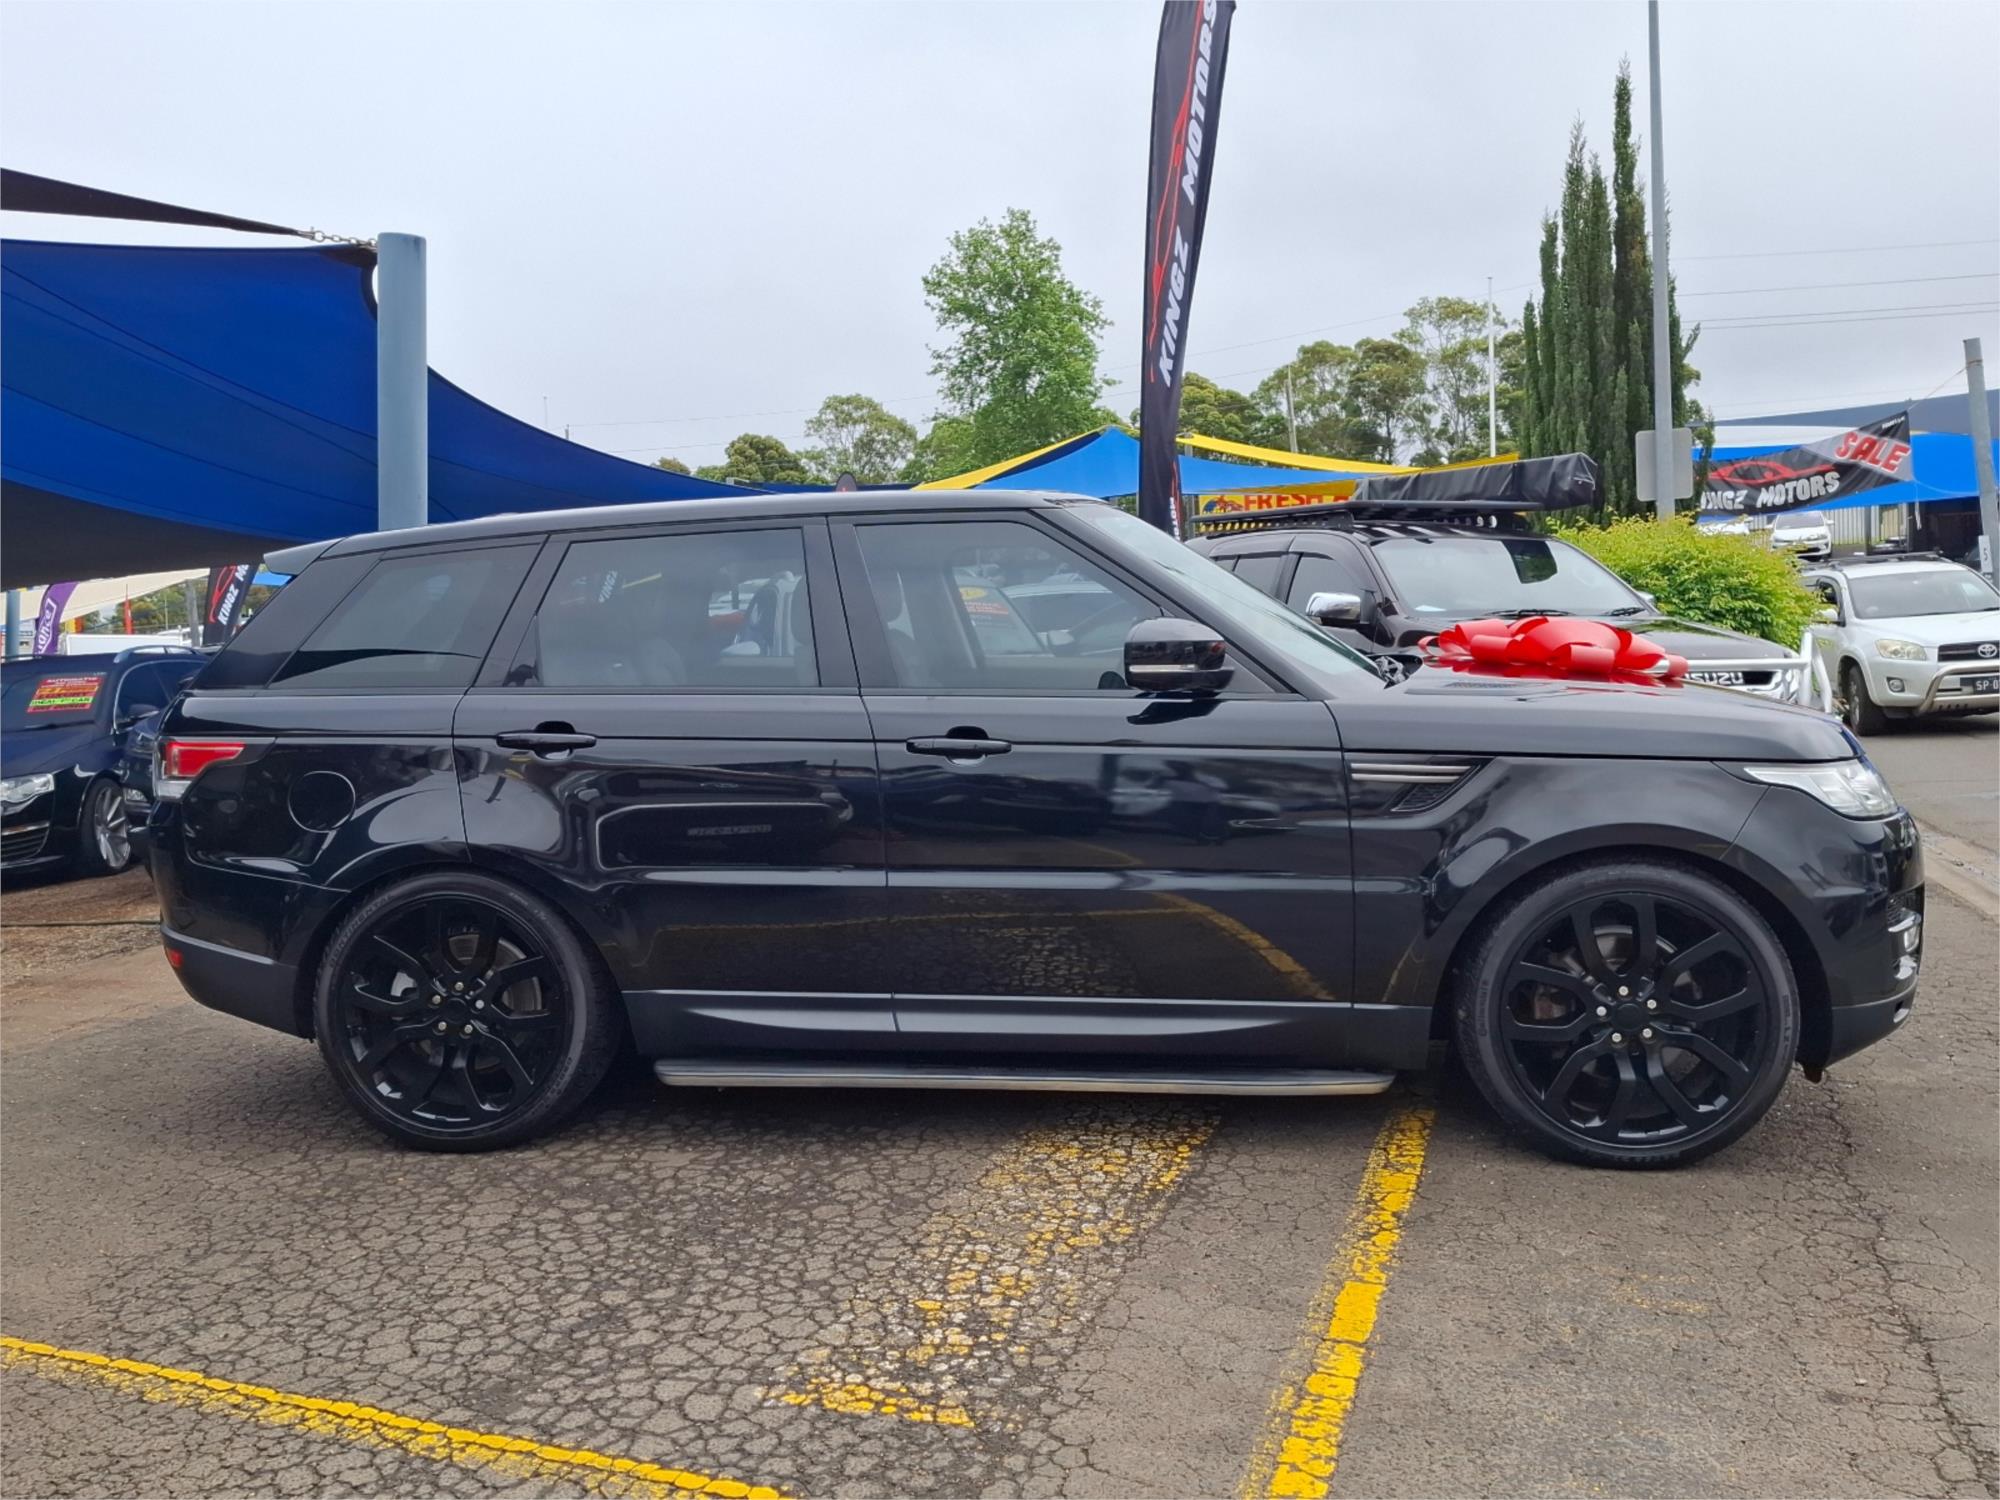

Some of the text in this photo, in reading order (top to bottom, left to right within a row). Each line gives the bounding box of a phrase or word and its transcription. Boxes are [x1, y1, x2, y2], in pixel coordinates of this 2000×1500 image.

[1160, 0, 1217, 387] KINGZ MOTORS
[1835, 431, 1910, 473] SALE
[1756, 471, 1840, 508] MOTORS
[218, 583, 239, 625] KINGZ
[1684, 671, 1744, 685] ISUZU
